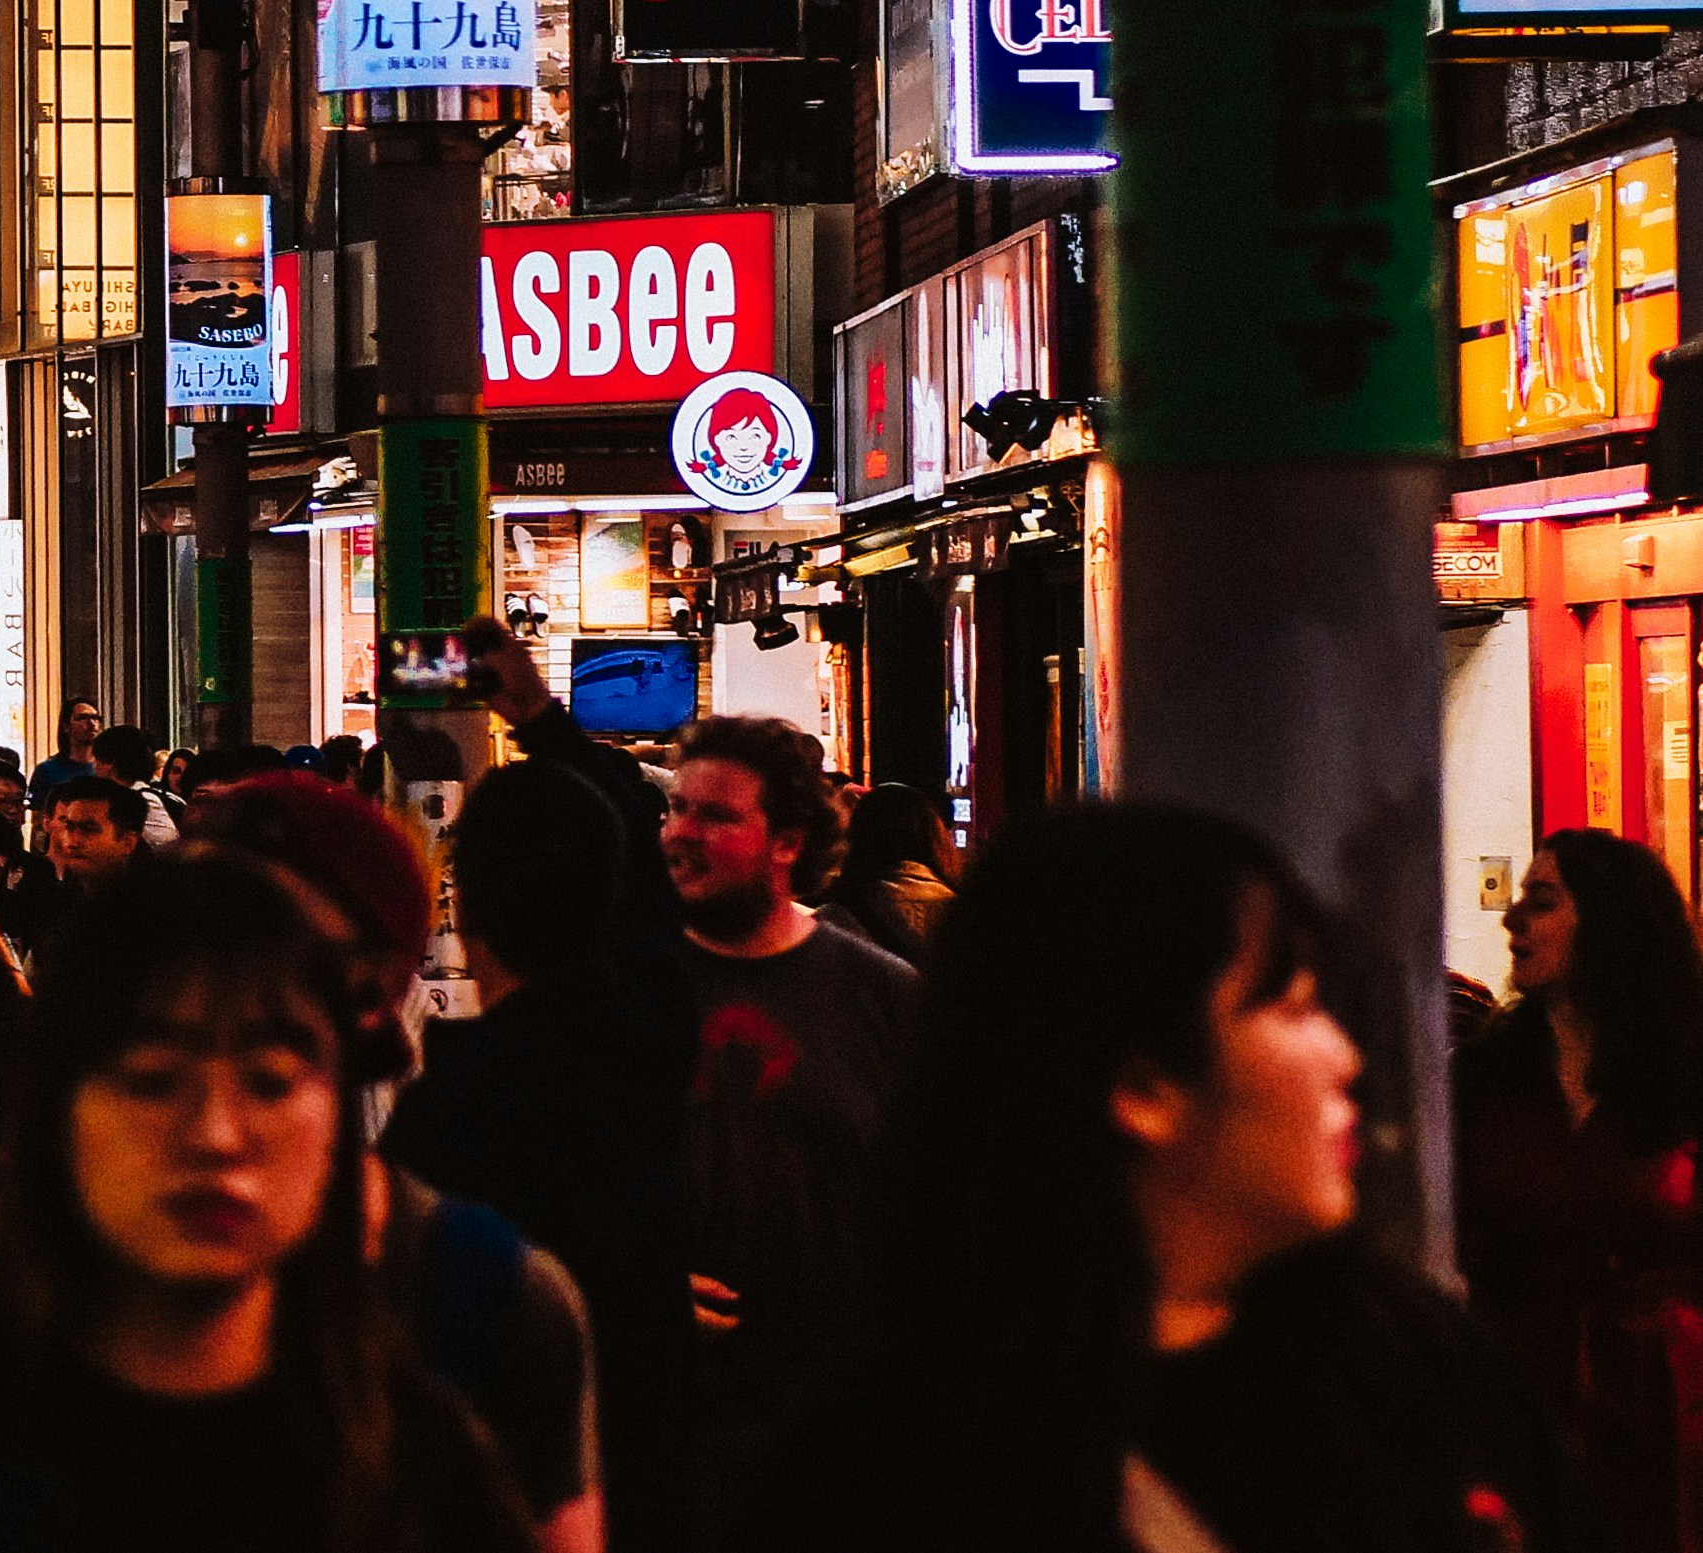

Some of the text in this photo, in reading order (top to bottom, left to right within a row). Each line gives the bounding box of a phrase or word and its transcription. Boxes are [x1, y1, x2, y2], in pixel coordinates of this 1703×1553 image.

[351, 1, 522, 52] 九十九島
[198, 322, 264, 345] SASEBO
[174, 361, 261, 390] 九十九島
